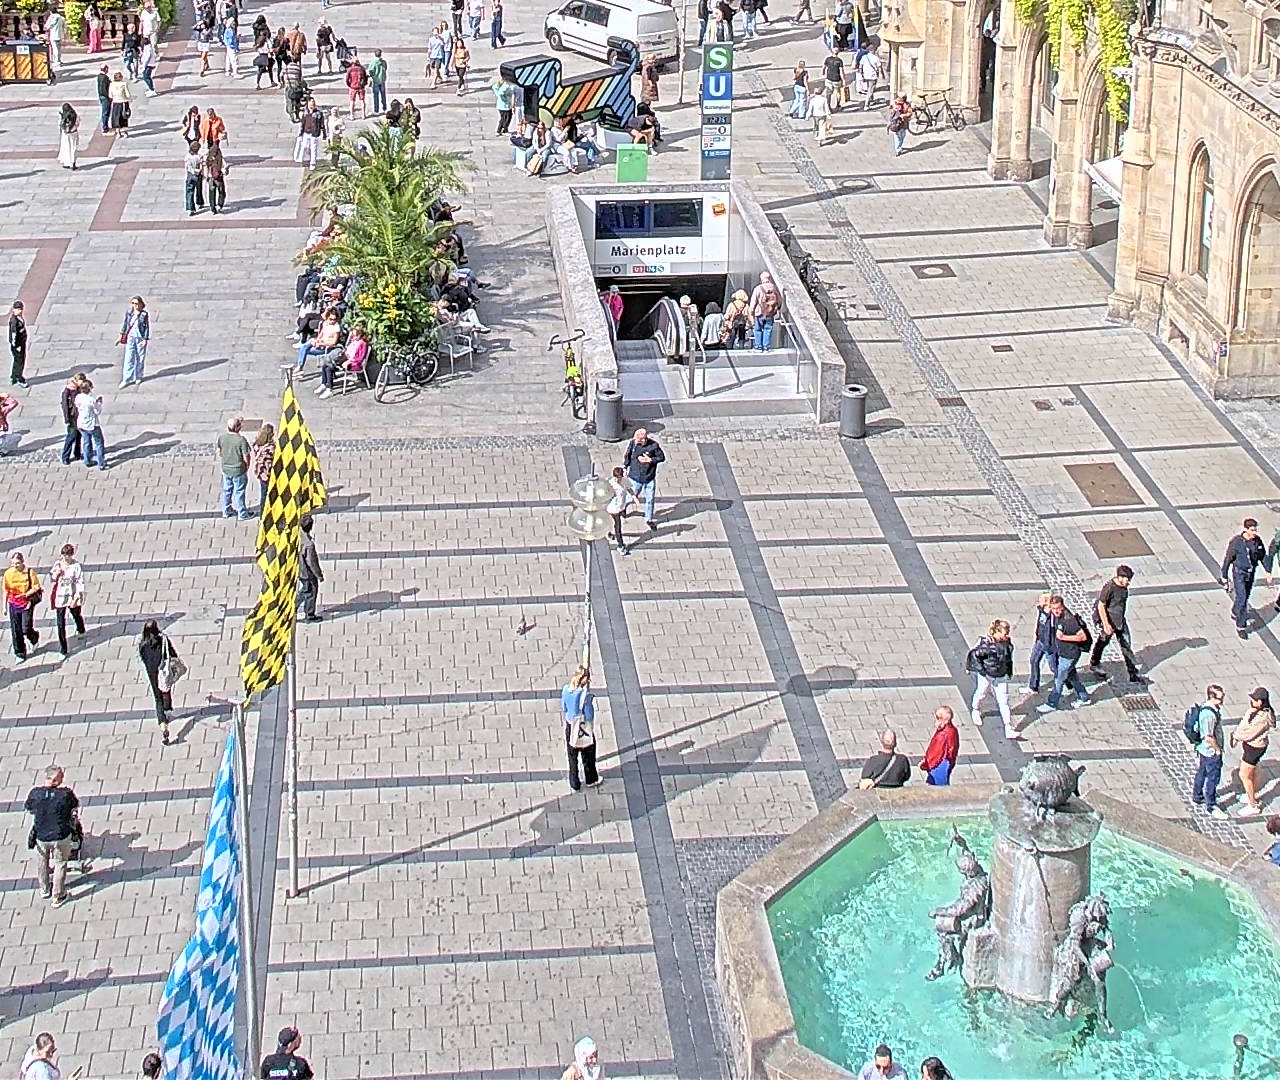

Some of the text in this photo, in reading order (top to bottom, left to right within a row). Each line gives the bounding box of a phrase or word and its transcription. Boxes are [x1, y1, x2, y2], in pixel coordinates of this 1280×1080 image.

[709, 46, 728, 69] S
[709, 75, 726, 97] U
[610, 244, 687, 258] Marienplatz
